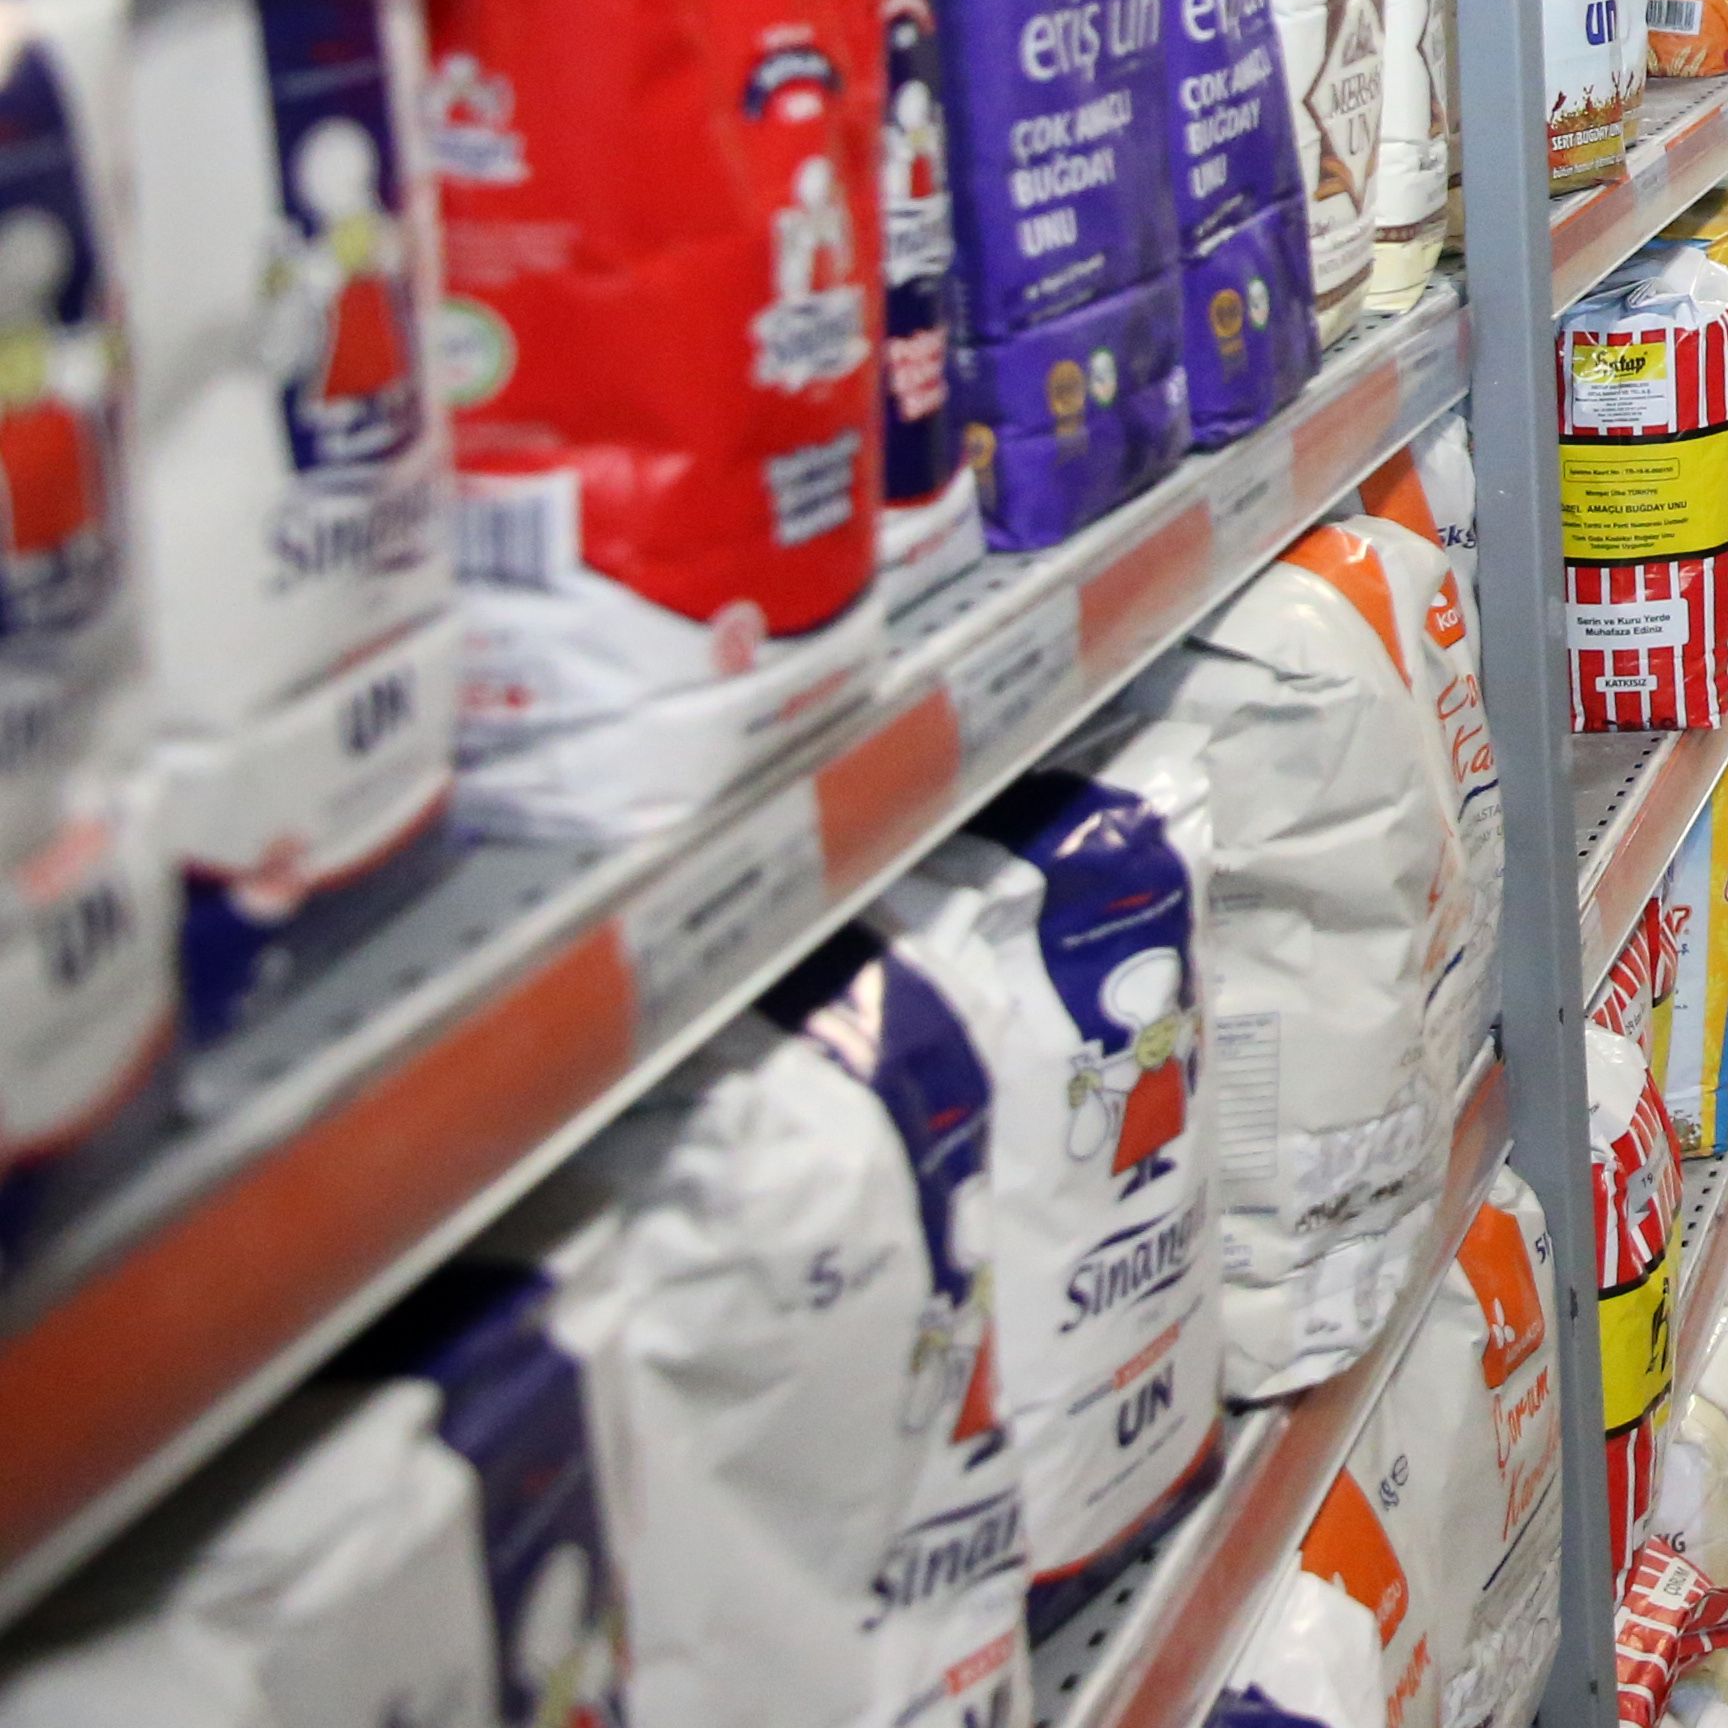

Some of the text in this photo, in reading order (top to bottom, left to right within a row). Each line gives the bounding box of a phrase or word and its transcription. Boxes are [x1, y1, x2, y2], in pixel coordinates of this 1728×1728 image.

[1587, 504, 1623, 514] AMAÇLI
[1625, 502, 1665, 513] BUĞDAY
[1667, 501, 1688, 510] UNU
[1577, 617, 1601, 626] Serin
[1617, 617, 1641, 625] Kuru
[1644, 614, 1671, 623] Yerde
[1585, 626, 1663, 636] Muhafaza Ediniz
[1605, 678, 1647, 688] KATKISIZ
[1116, 1362, 1175, 1449] UN
